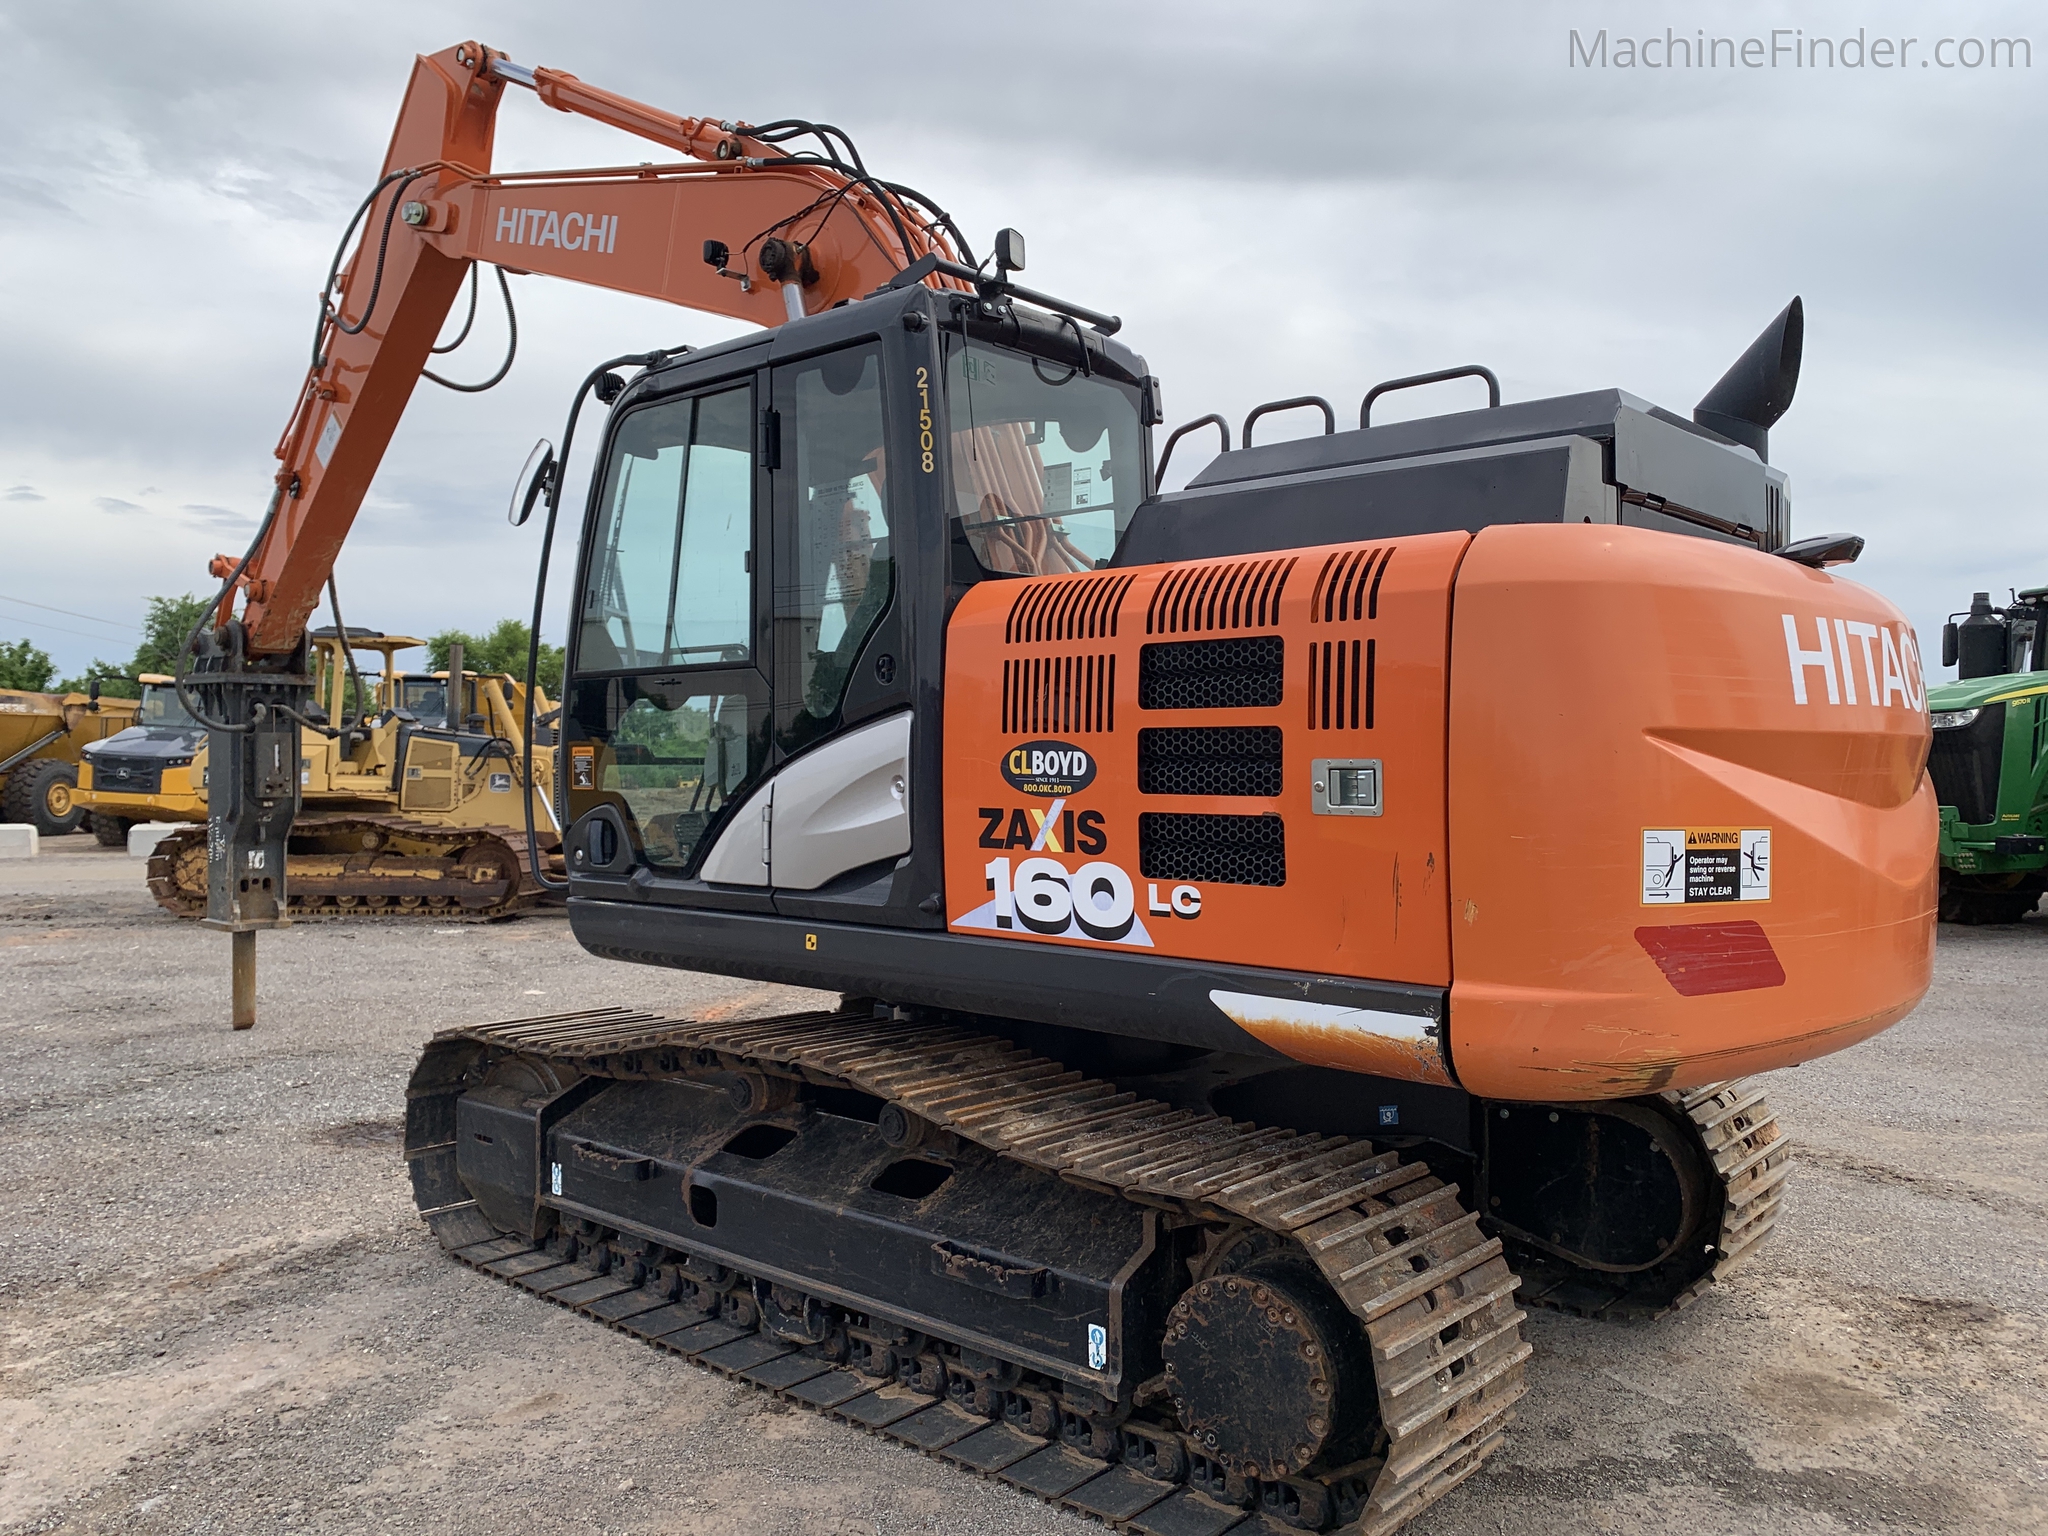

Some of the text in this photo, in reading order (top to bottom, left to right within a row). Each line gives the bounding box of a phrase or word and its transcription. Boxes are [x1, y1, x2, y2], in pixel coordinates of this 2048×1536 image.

[496, 206, 618, 254] HITACHI
[916, 366, 935, 473] 21508
[1009, 750, 1087, 776] CLBOYD
[1023, 783, 1072, 793] 800.OKC.BOYD
[978, 799, 1107, 856] ZAXIS
[1697, 832, 1738, 844] WARNING
[1689, 856, 1728, 865] Operator may
[1689, 866, 1707, 875] swing
[985, 857, 1202, 940] 160 LC
[1689, 886, 1732, 896] STAY CLEAR
